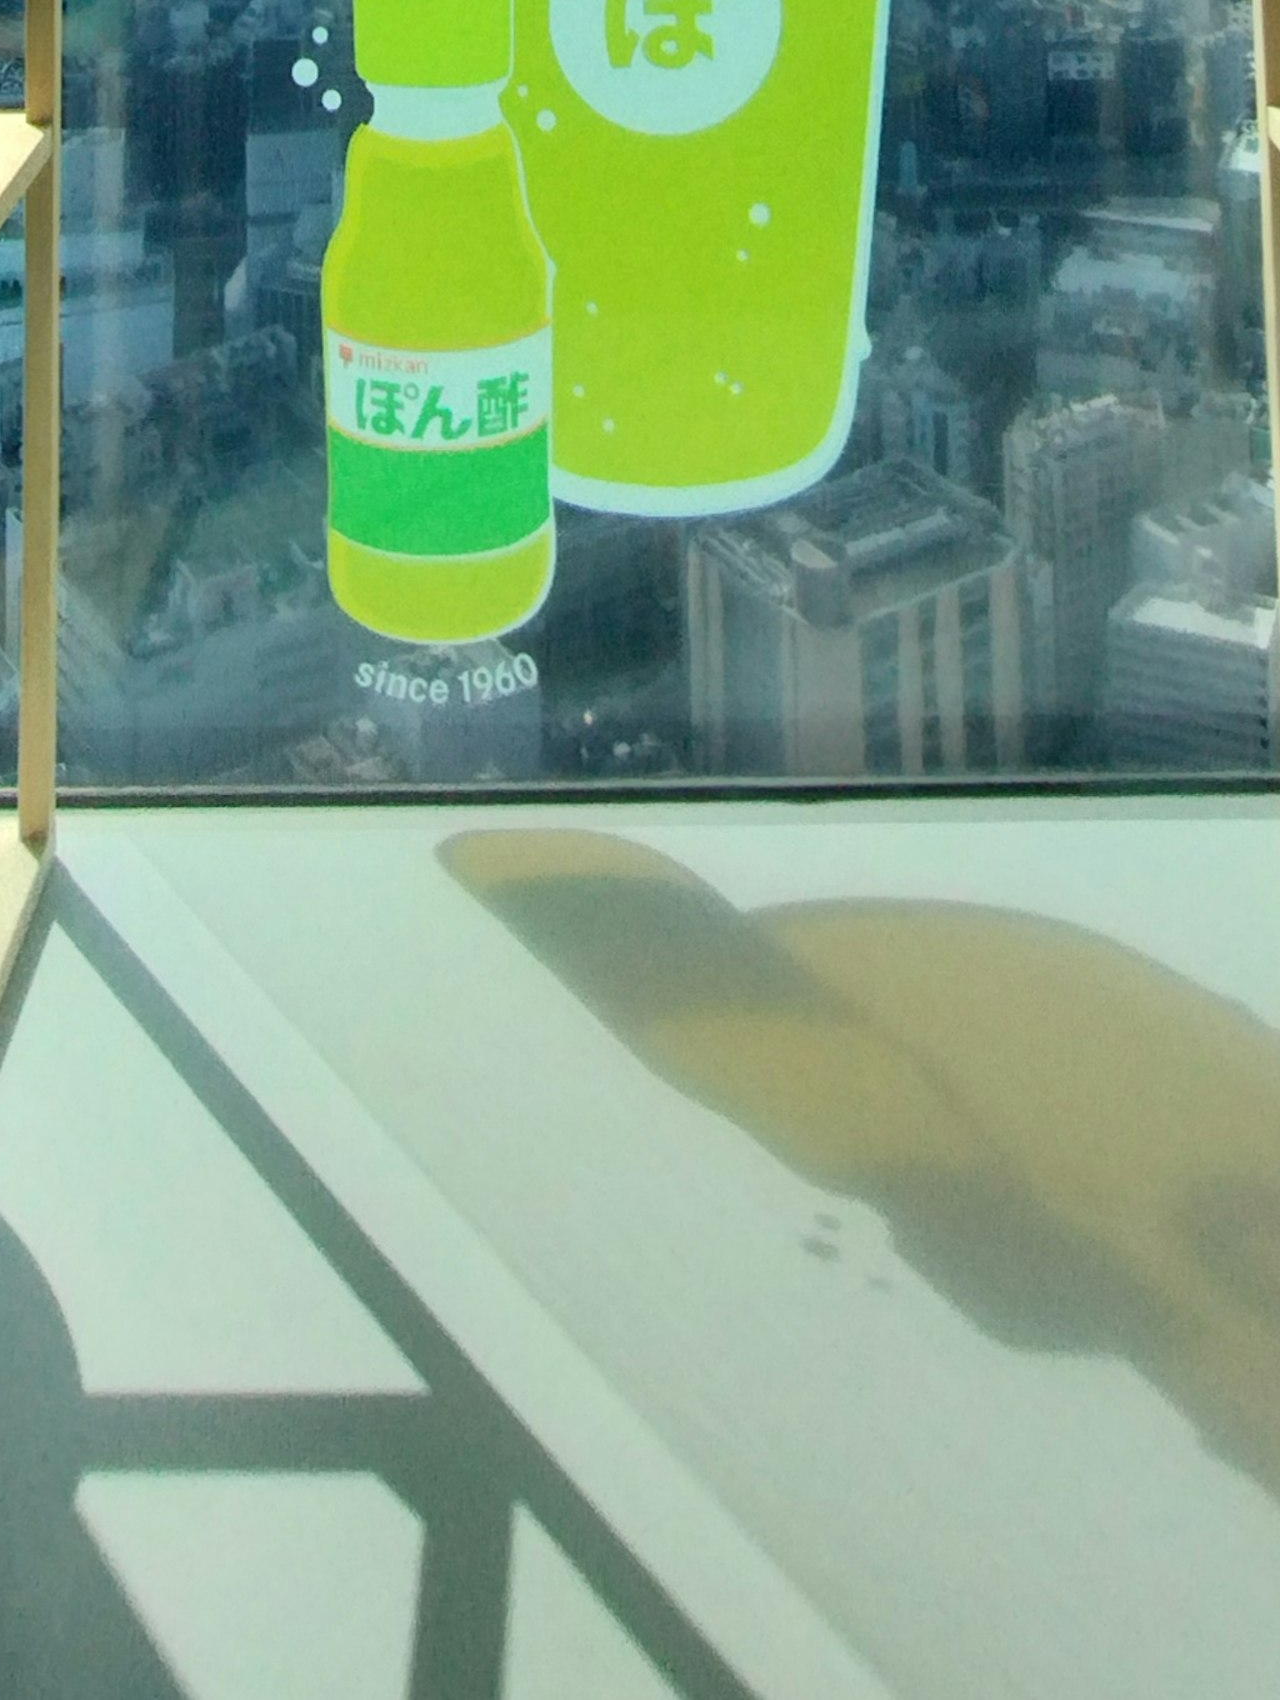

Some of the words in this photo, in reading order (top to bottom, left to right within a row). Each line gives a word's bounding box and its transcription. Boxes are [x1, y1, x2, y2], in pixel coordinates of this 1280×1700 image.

[359, 350, 429, 374] mizkan
[355, 370, 530, 440] ぽん酢
[354, 660, 449, 704] since
[458, 652, 539, 704] 1960
